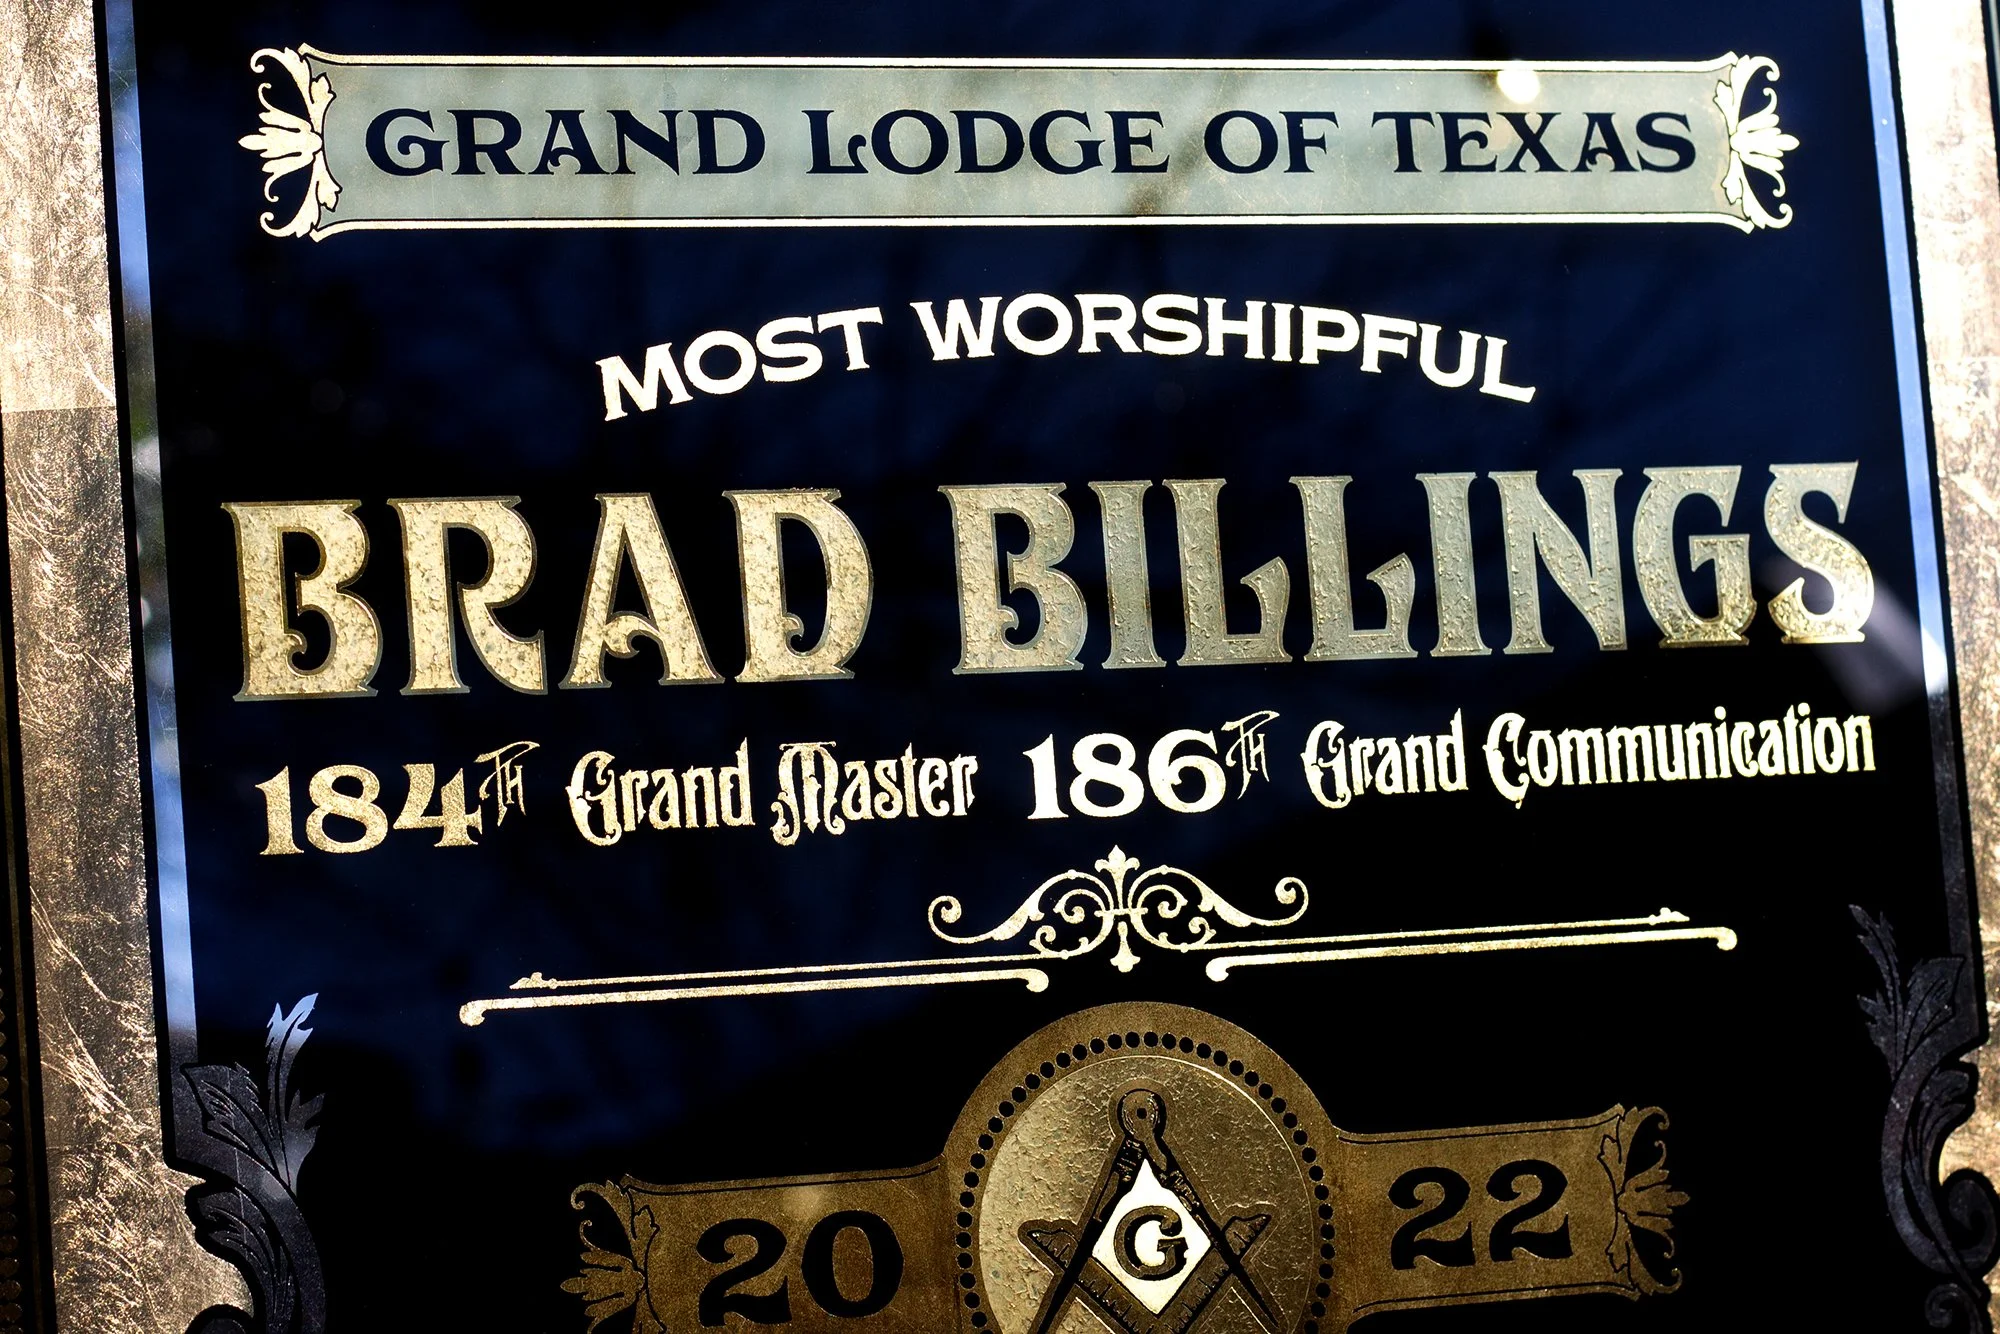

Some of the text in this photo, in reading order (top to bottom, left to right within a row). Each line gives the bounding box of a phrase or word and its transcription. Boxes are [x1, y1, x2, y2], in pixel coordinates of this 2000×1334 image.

[365, 109, 1695, 175] GRAND LODGE OF TEXAS
[596, 293, 1537, 422] MOST WORSHIPFUL
[221, 462, 1877, 702] BRAD BILLINGS
[565, 737, 757, 848] Grand
[770, 741, 978, 847] Master
[1300, 707, 1470, 809] Grand
[1483, 702, 1877, 810] Communication
[697, 1159, 1573, 1326] 20 22
[1114, 1205, 1189, 1281] G
